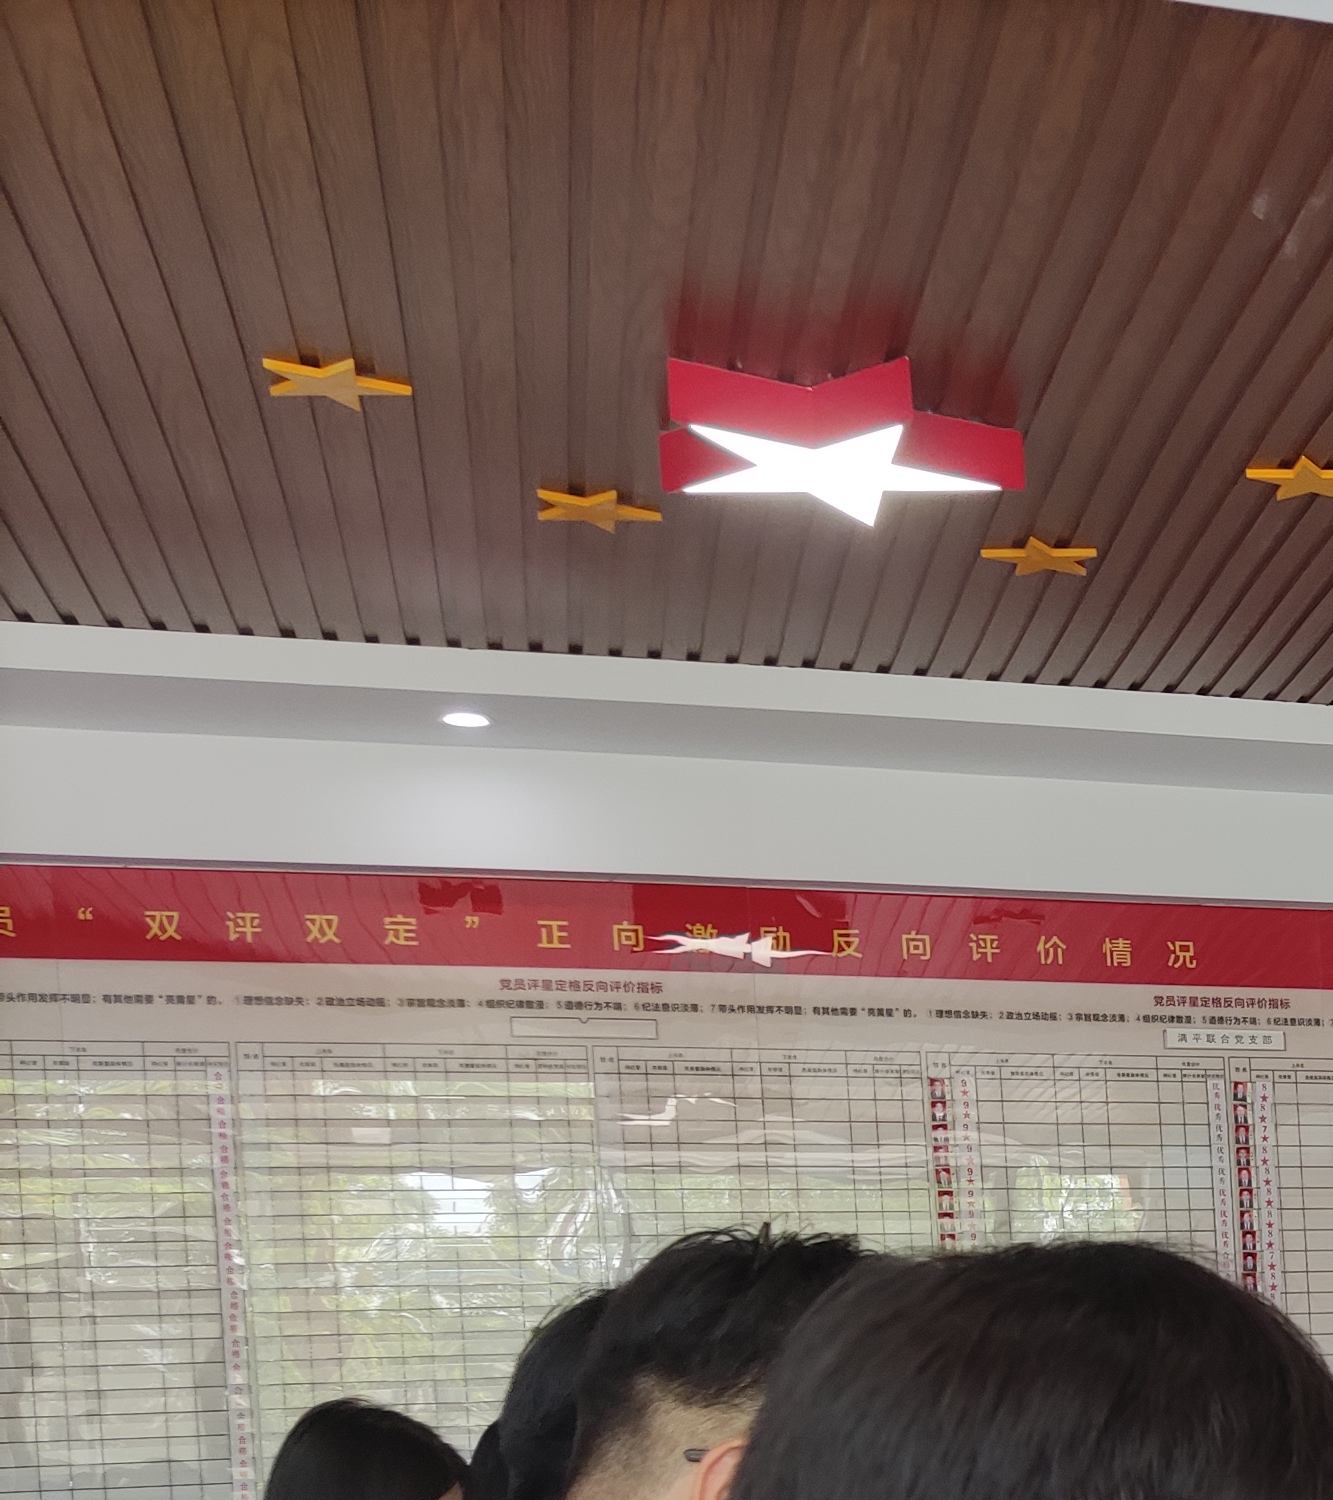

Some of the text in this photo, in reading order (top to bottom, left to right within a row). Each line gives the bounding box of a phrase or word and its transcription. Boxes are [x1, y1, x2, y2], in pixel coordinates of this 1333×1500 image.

[499, 978, 664, 994] 党员评星定格反向评价指标
[1153, 995, 1291, 1010] 党员评星定格反向评价指标
[961, 1079, 967, 1087] 9
[1261, 1083, 1267, 1091] 8
[963, 1101, 969, 1109] 9
[1260, 1103, 1266, 1111] 8
[962, 1123, 969, 1131] 9
[1262, 1125, 1267, 1133] 7
[966, 1144, 972, 1152] 9
[967, 1167, 973, 1175] 9
[968, 1189, 974, 1197] 9
[970, 1232, 977, 1240] 9
[1267, 1230, 1273, 1238] 8
[1269, 1251, 1275, 1260] 7
[1271, 1272, 1276, 1280] 8
